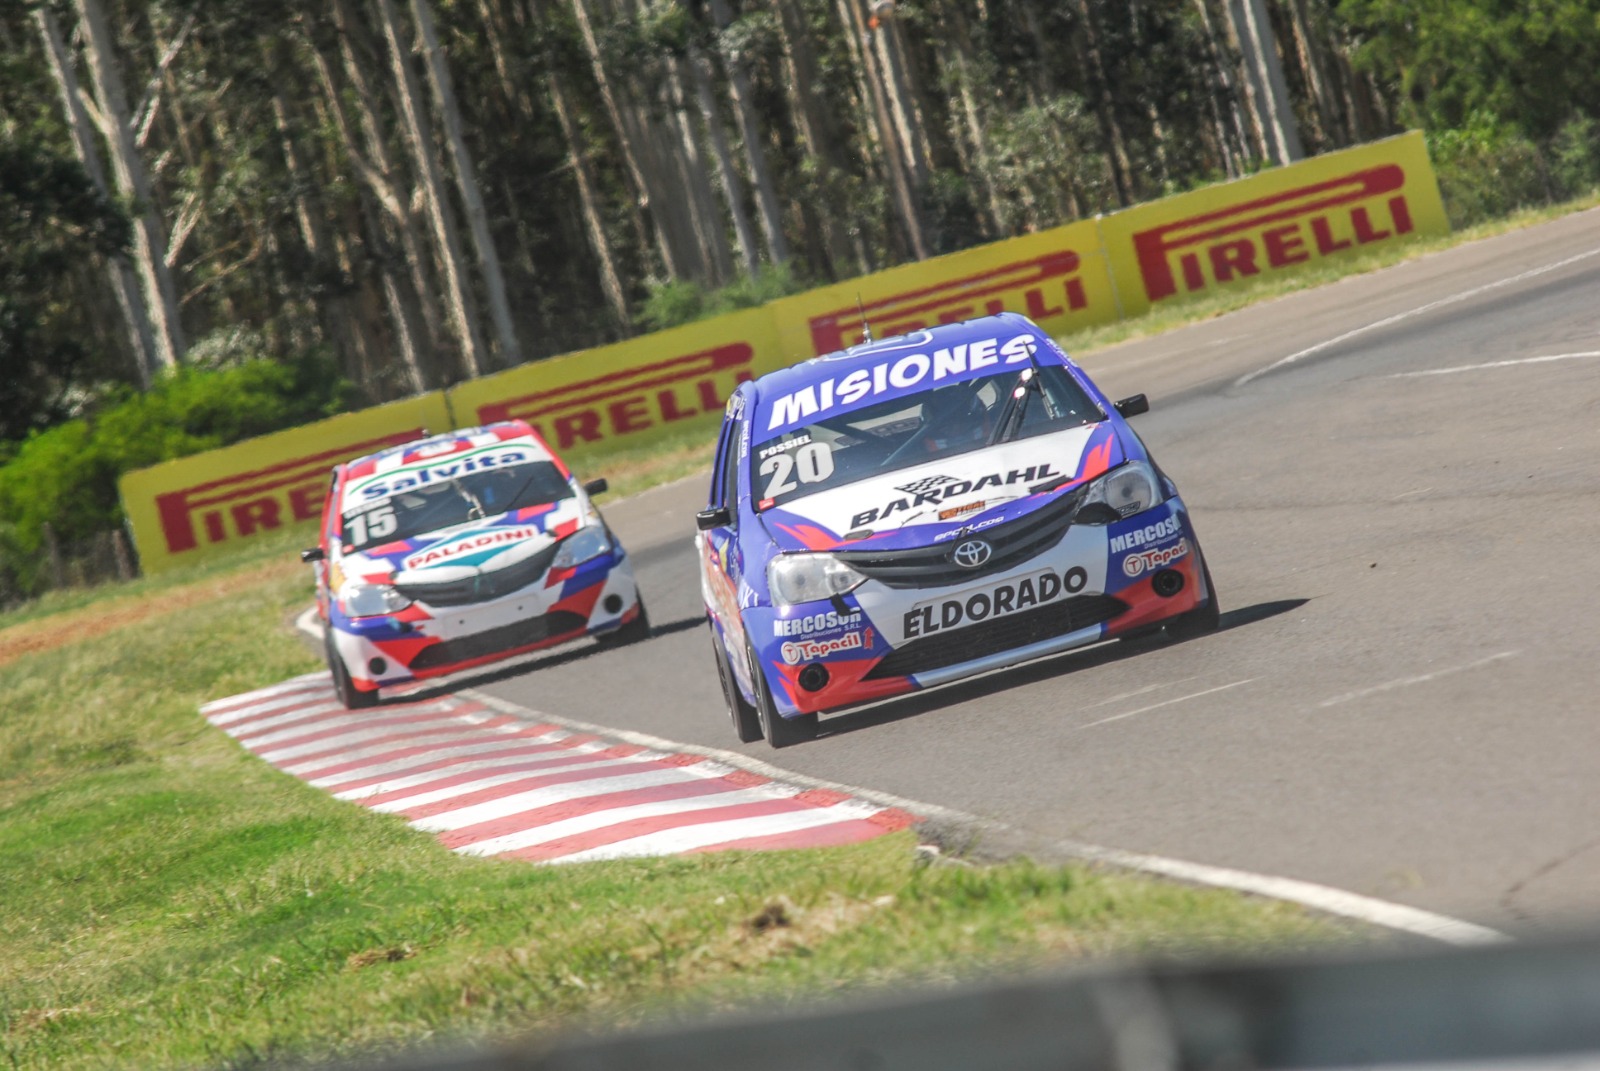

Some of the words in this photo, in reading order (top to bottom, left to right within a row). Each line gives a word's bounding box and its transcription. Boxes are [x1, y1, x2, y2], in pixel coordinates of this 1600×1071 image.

[1132, 163, 1413, 302] PIRELLI
[477, 342, 754, 449] PRELL
[768, 334, 1037, 430] MISIONES
[760, 434, 811, 459] POSSIEL
[760, 442, 834, 498] 20
[154, 427, 425, 553] PIRE
[362, 451, 526, 500] Salvita
[850, 464, 1059, 529] BARDAHL
[344, 506, 397, 546] 15
[408, 529, 532, 568] PALADINI
[1109, 514, 1181, 553] MERCOS
[903, 566, 1088, 639] ELDORADO
[796, 634, 860, 658] Tapacil
